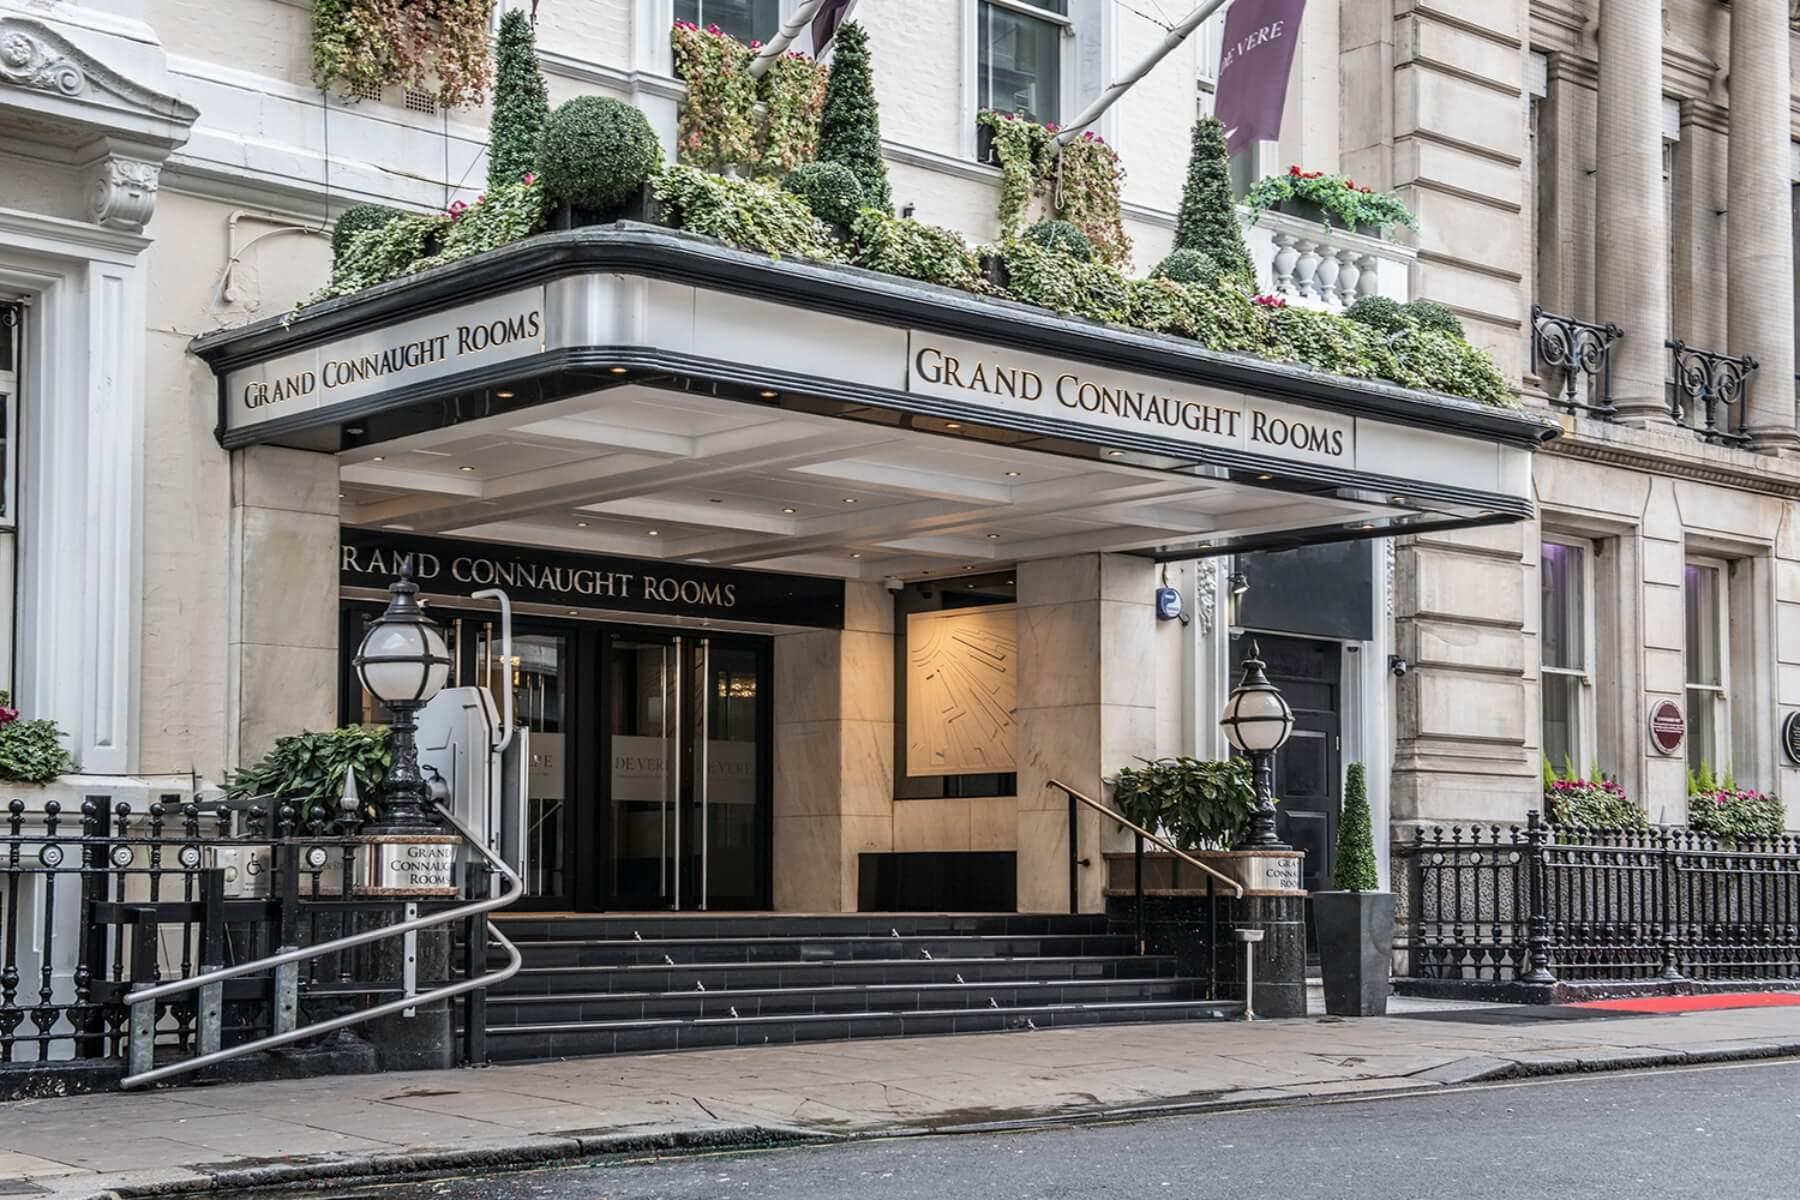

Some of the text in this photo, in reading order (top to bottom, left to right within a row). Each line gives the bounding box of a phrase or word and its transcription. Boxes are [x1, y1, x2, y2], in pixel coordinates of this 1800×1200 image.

[1237, 20, 1284, 56] VERE
[244, 311, 540, 409] GRAND CONNAUGHT ROOMS
[915, 347, 1343, 456] GRAND CONNAUGHT ROOMS
[341, 544, 736, 608] RAND CONNAUGHT ROOMS
